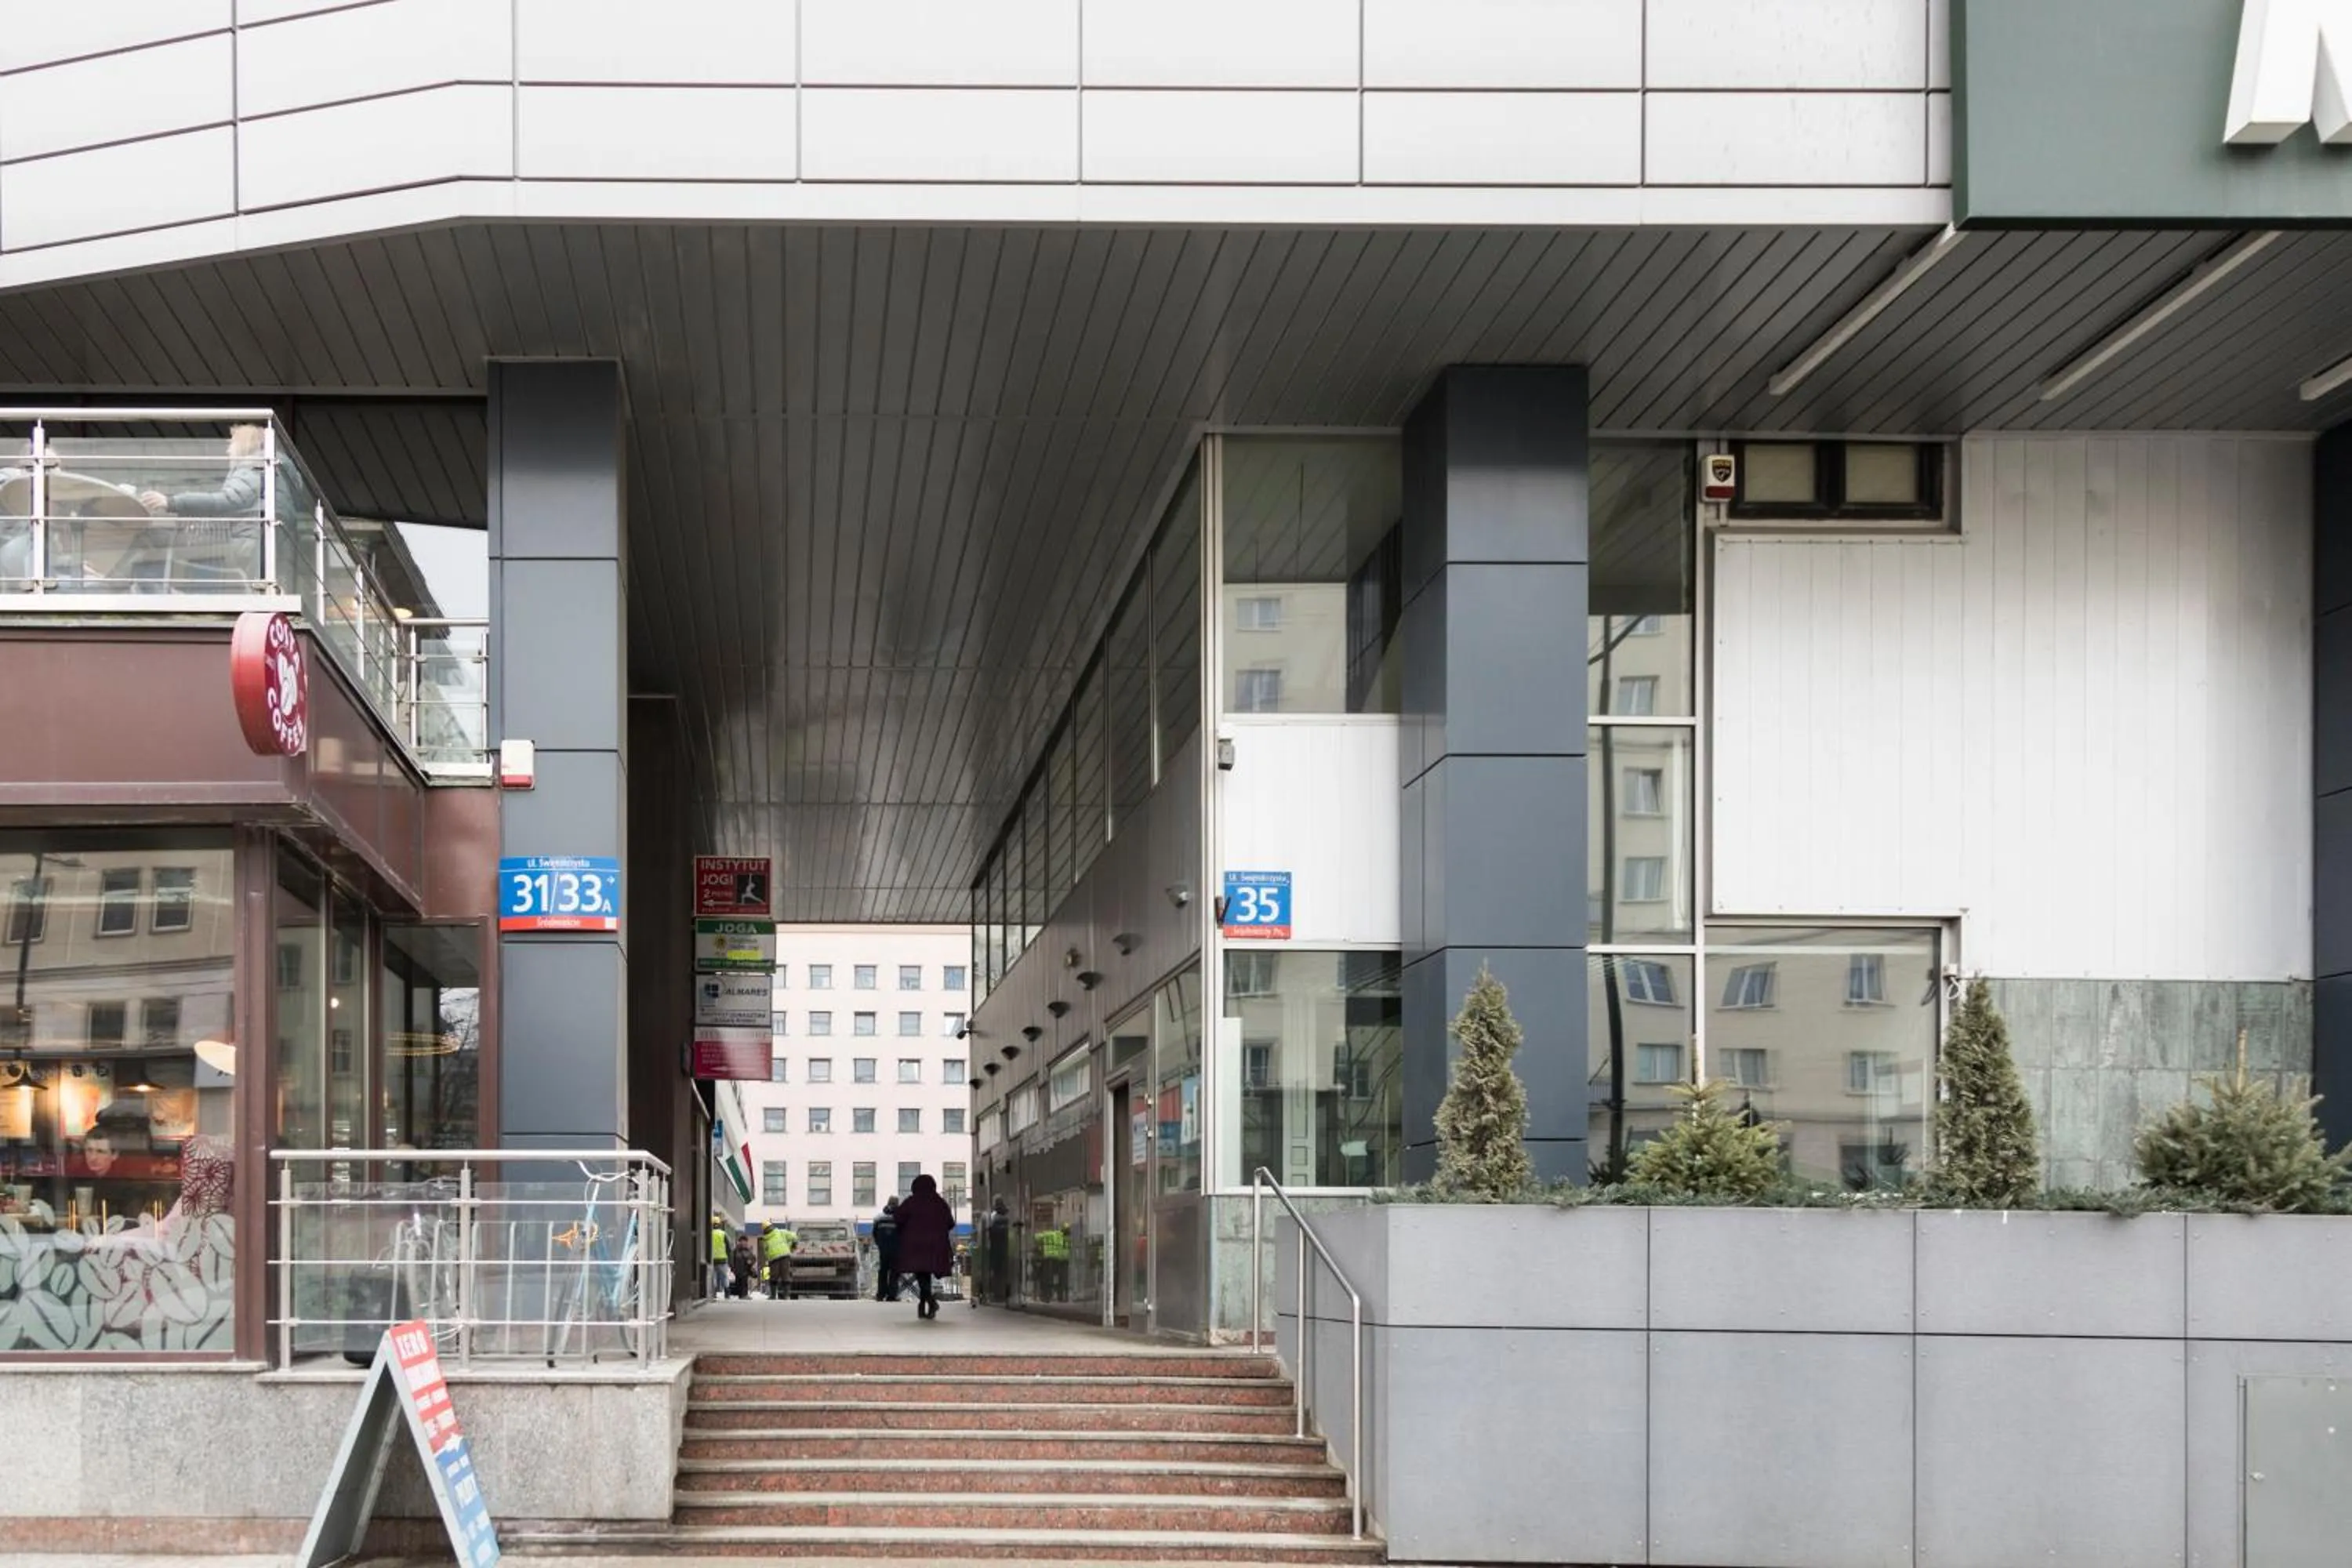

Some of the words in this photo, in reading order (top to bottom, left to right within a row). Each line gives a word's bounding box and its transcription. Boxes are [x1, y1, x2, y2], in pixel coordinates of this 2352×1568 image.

[267, 687, 303, 750] COFFEE
[701, 858, 767, 871] INSTYTUT
[701, 873, 733, 885] JOGI
[1236, 887, 1279, 922] 35
[715, 923, 757, 934] JOGA
